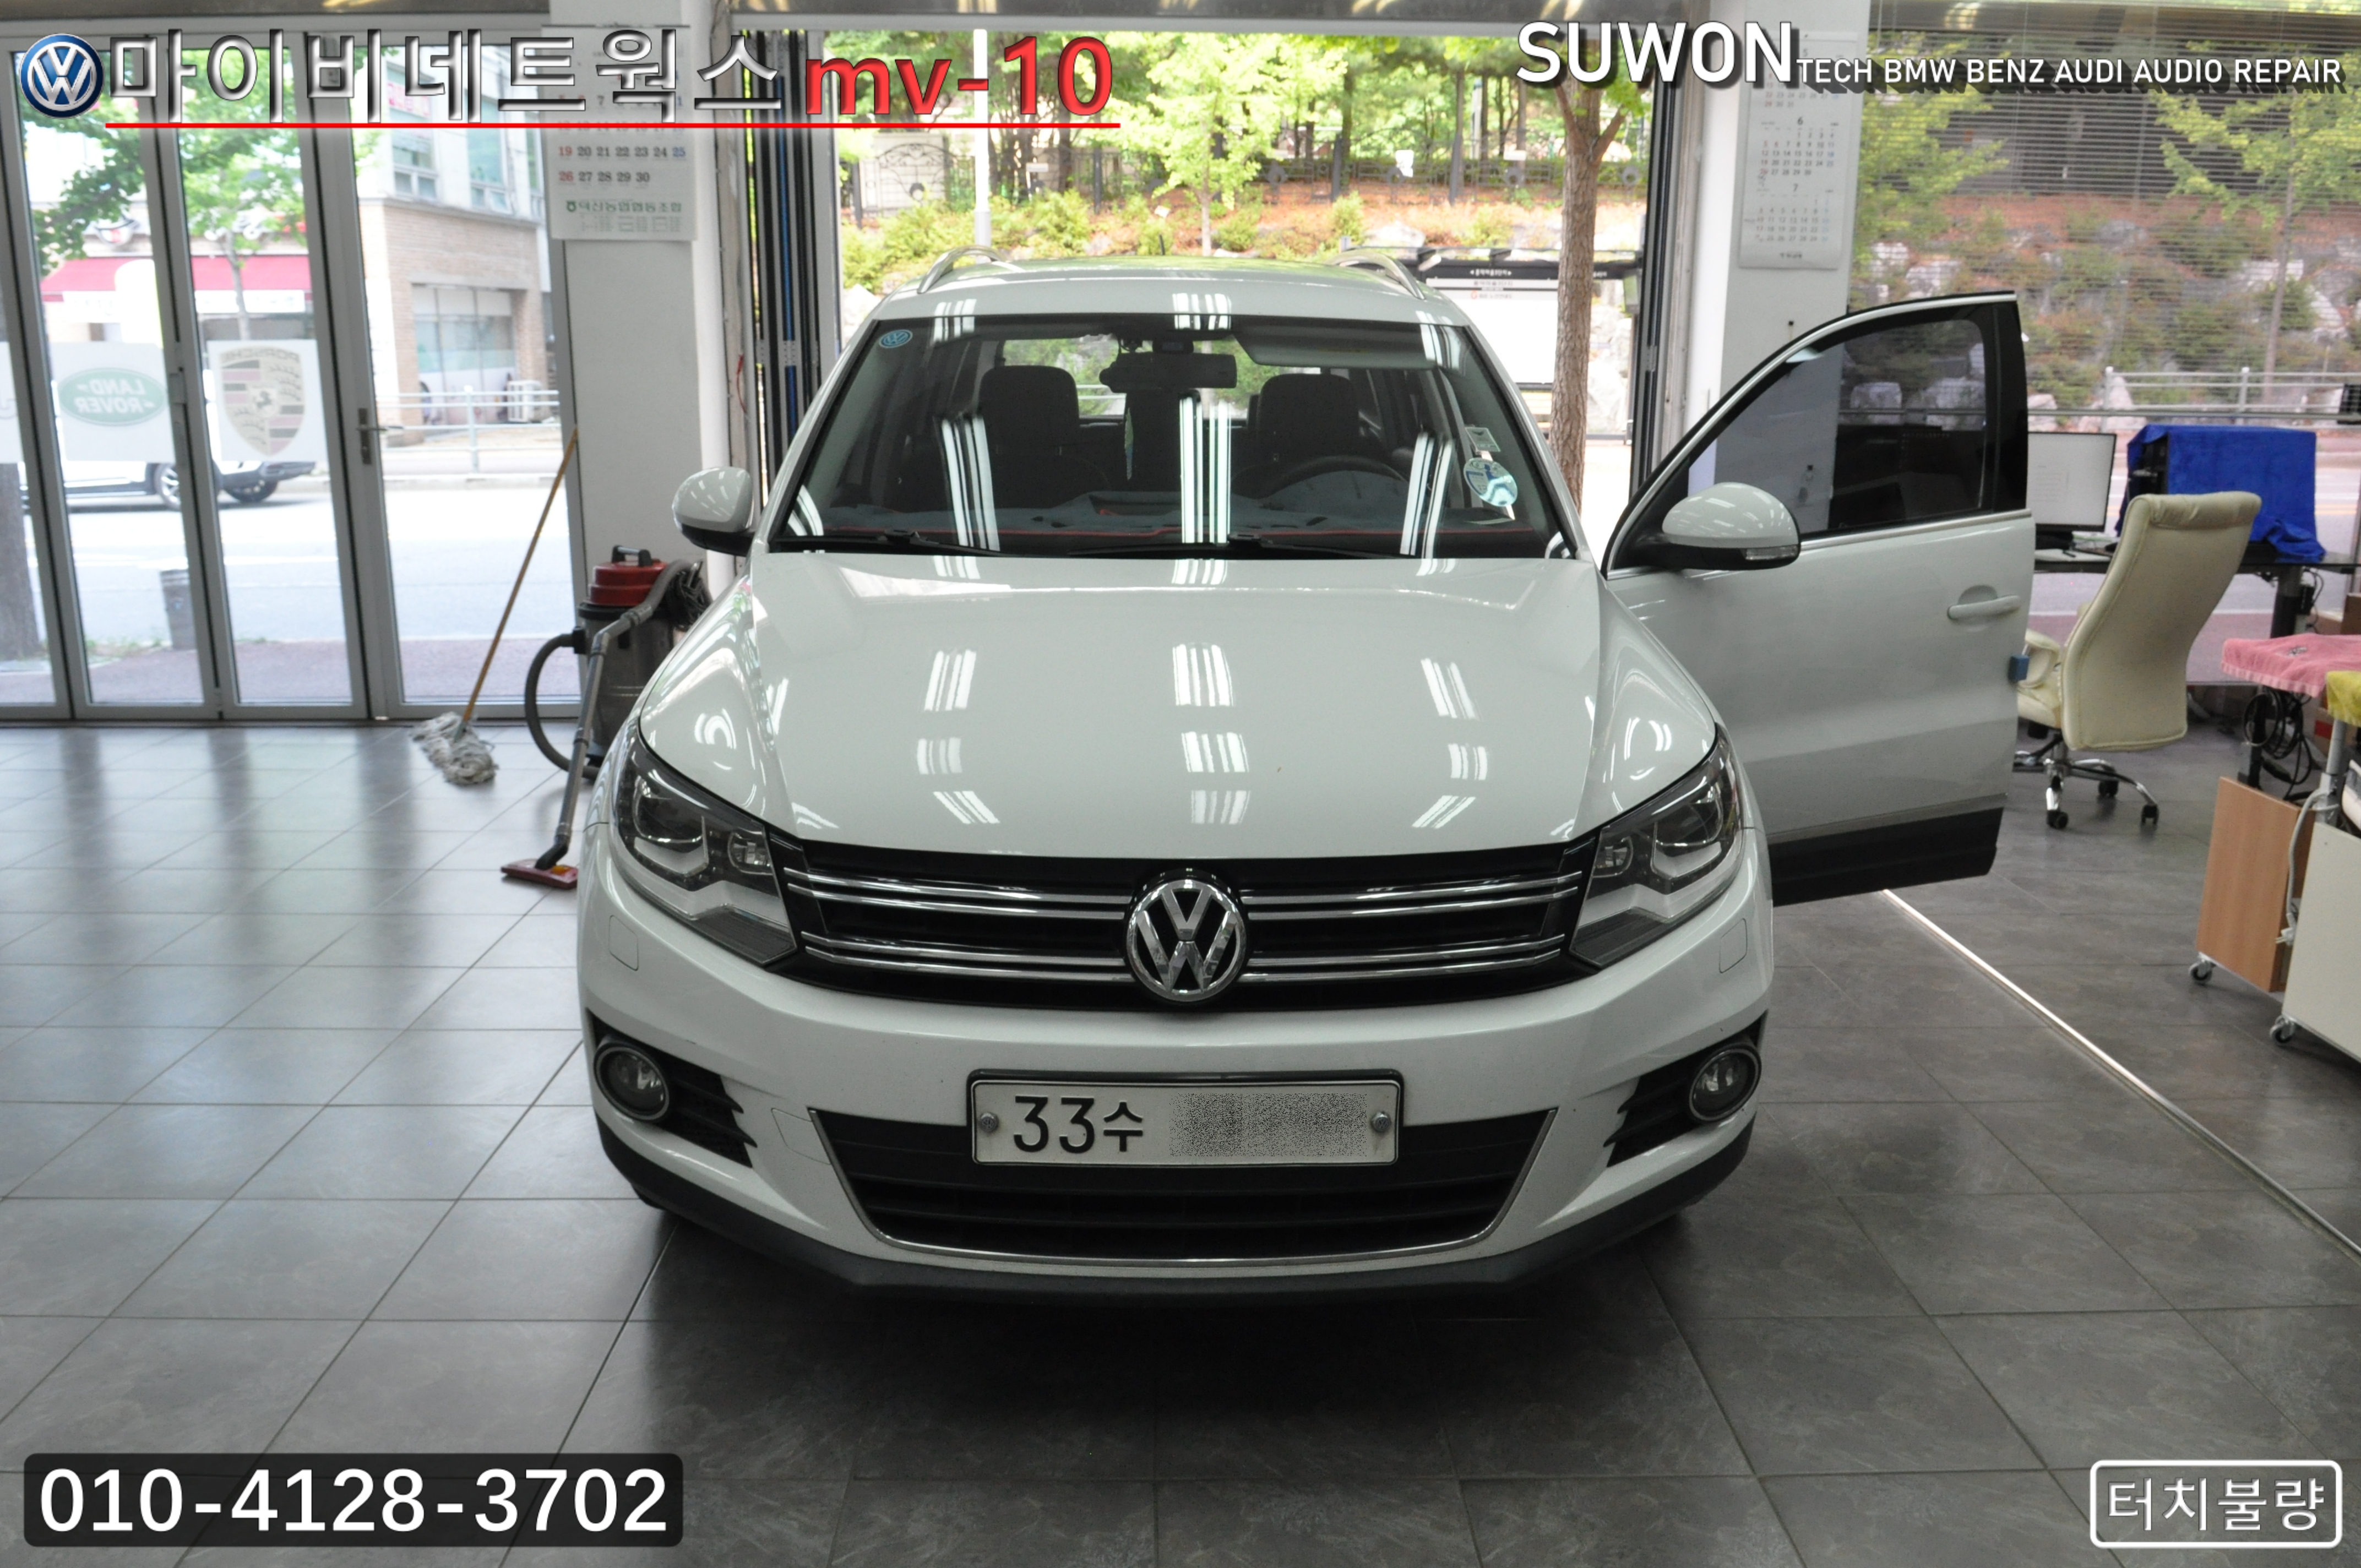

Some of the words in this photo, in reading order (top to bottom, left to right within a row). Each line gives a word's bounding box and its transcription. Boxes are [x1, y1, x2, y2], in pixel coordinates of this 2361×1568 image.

[1797, 116, 1804, 126] 6
[559, 146, 573, 157] 19
[578, 146, 591, 157] 20
[596, 146, 610, 157] 21
[615, 146, 629, 157] 22
[634, 146, 649, 157] 23
[653, 146, 667, 157] 24
[672, 146, 686, 157] 25
[558, 171, 574, 182] 26
[578, 171, 592, 182] 27
[597, 171, 612, 182] 28
[616, 171, 631, 182] 29
[635, 171, 650, 182] 30
[1793, 183, 1798, 192] 7
[1013, 1095, 1144, 1153] 33수
